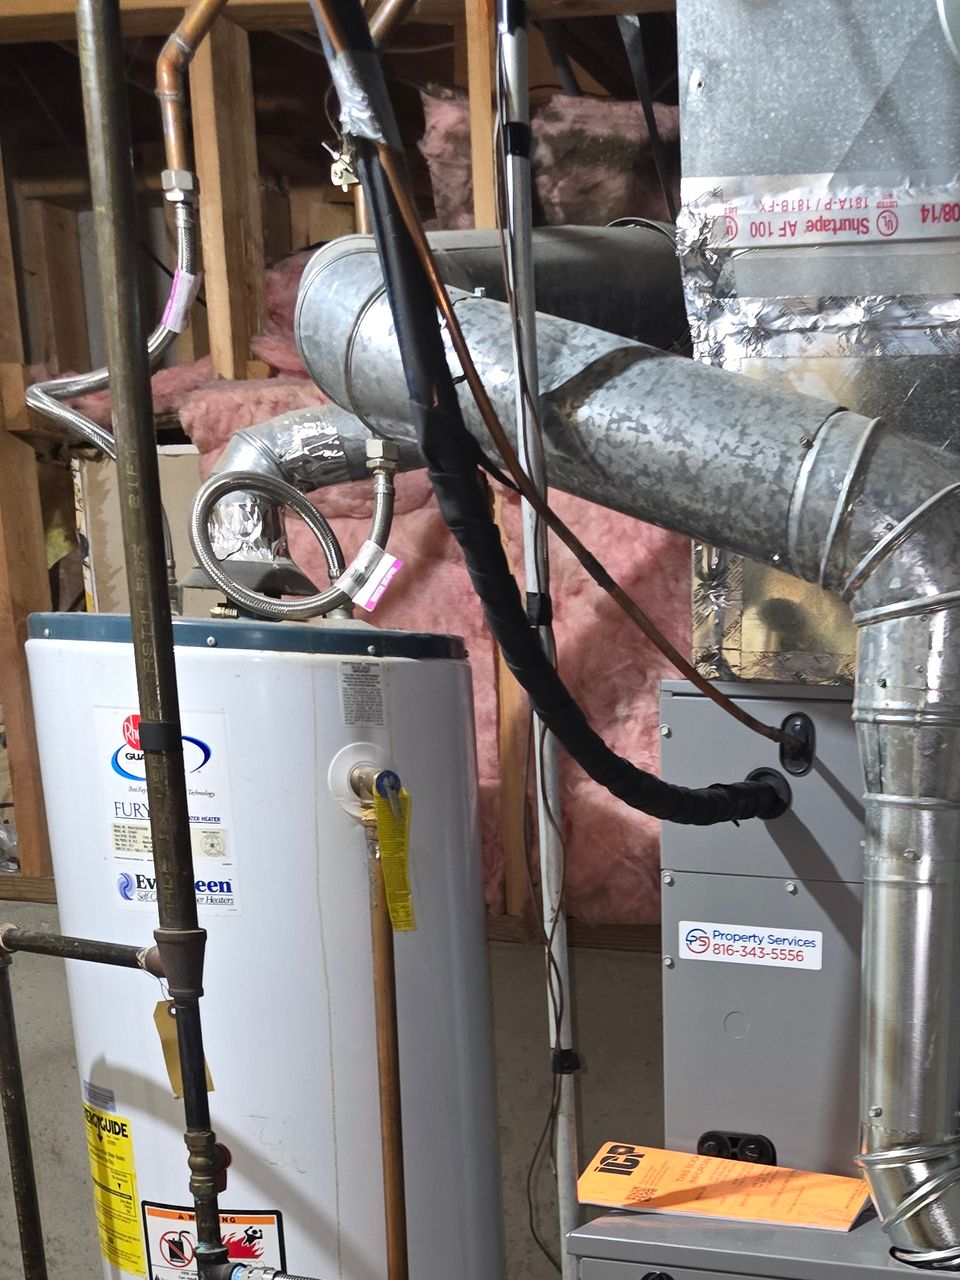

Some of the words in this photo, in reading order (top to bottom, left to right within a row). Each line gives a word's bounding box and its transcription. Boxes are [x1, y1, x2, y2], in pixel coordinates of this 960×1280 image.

[749, 220, 775, 238] 100
[778, 220, 798, 237] AF
[805, 216, 870, 236] Shurtape
[205, 896, 234, 905] Heaters
[712, 929, 765, 946] Property
[767, 934, 817, 948] Services
[712, 943, 805, 962] 816-343-5556
